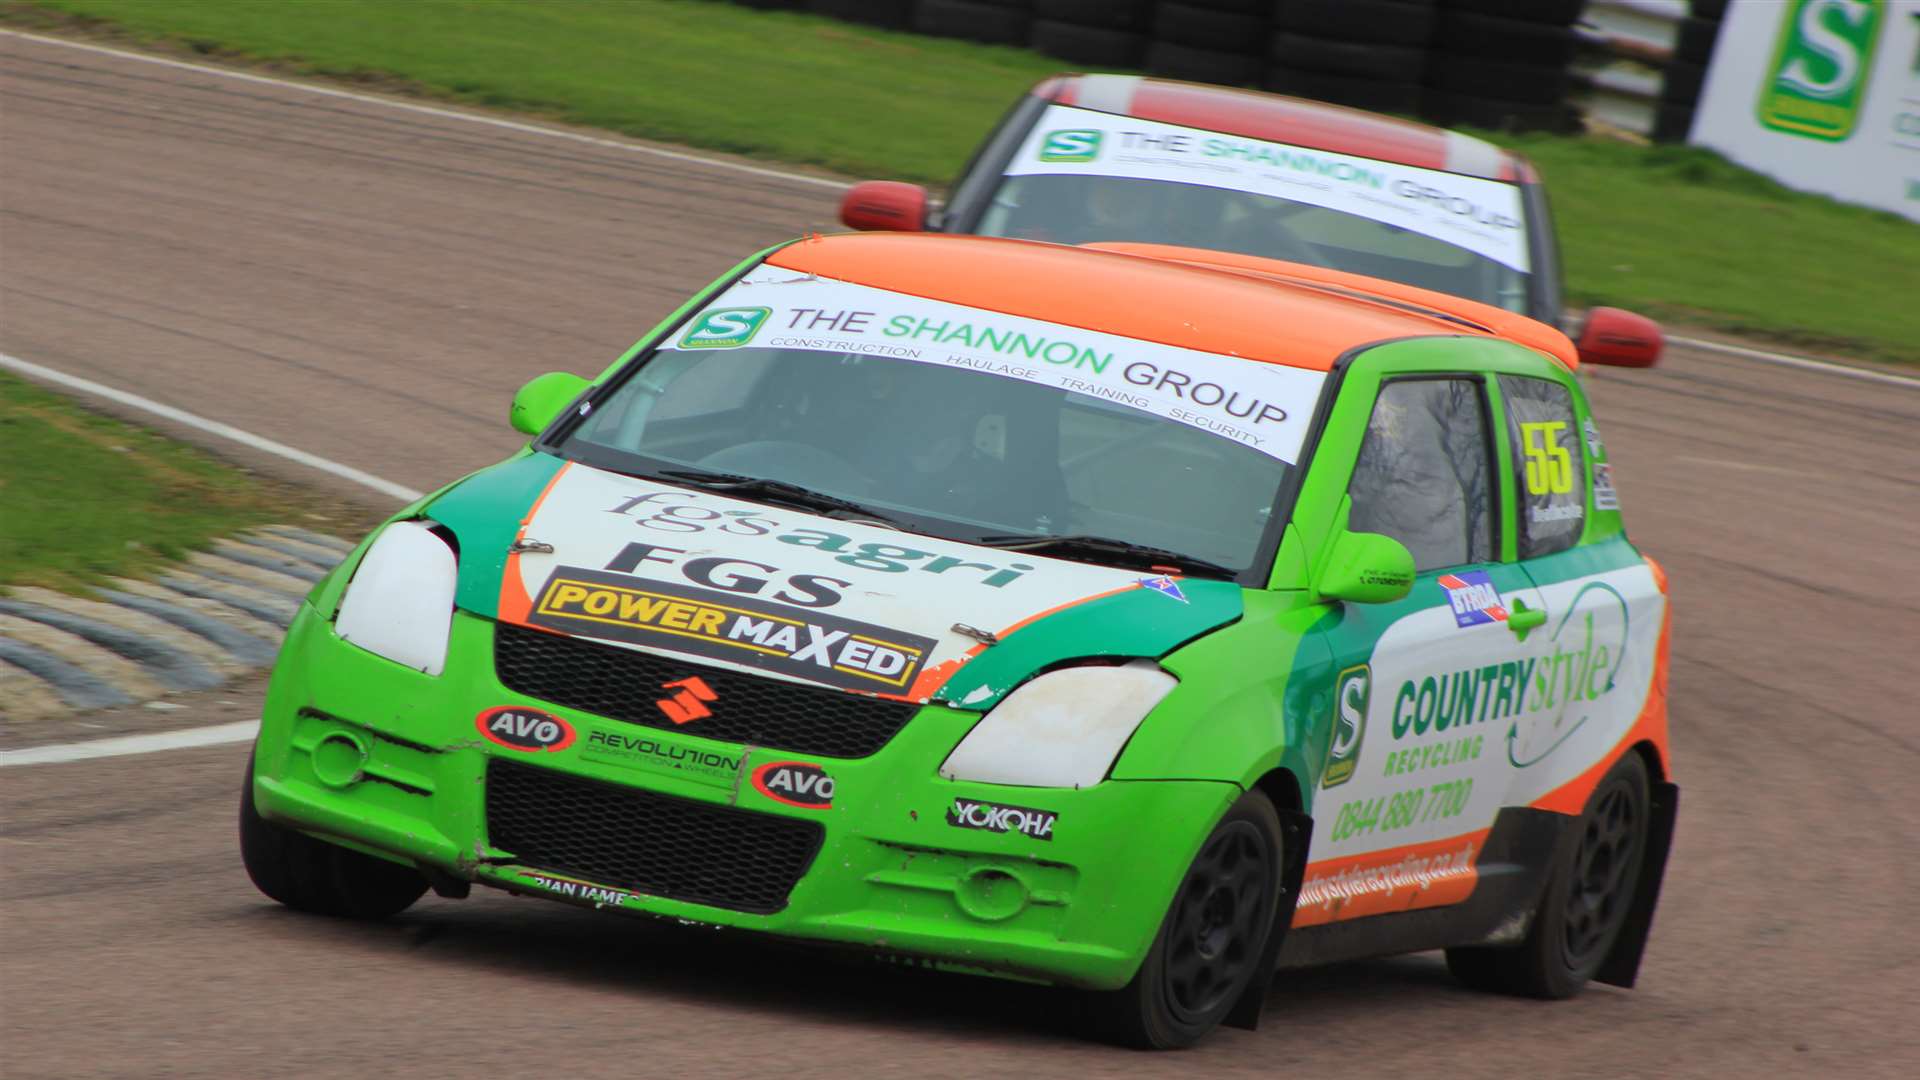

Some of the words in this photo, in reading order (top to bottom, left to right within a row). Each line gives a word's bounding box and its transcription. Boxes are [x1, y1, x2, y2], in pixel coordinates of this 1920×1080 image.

[1118, 131, 1193, 153] THE
[1201, 138, 1386, 189] SHANNON
[1391, 179, 1521, 229] GROUP
[769, 336, 922, 359] CONSTRUCTION
[946, 354, 1039, 380] HAULAGE
[1060, 376, 1150, 408] TRAINING
[1168, 406, 1265, 446] SECURITY
[788, 308, 876, 333] THE
[882, 314, 1114, 375] SHANNON
[1122, 361, 1288, 425] GROUP
[1520, 421, 1573, 495] 55
[603, 541, 853, 608] FGS
[550, 584, 727, 636] POWER
[489, 712, 561, 743] AVO
[588, 731, 741, 771] REVOLUTION
[1383, 735, 1484, 778] RECYCLING
[1331, 796, 1386, 842] 0844
[1380, 787, 1425, 832] 880
[1421, 777, 1473, 823] 7700
